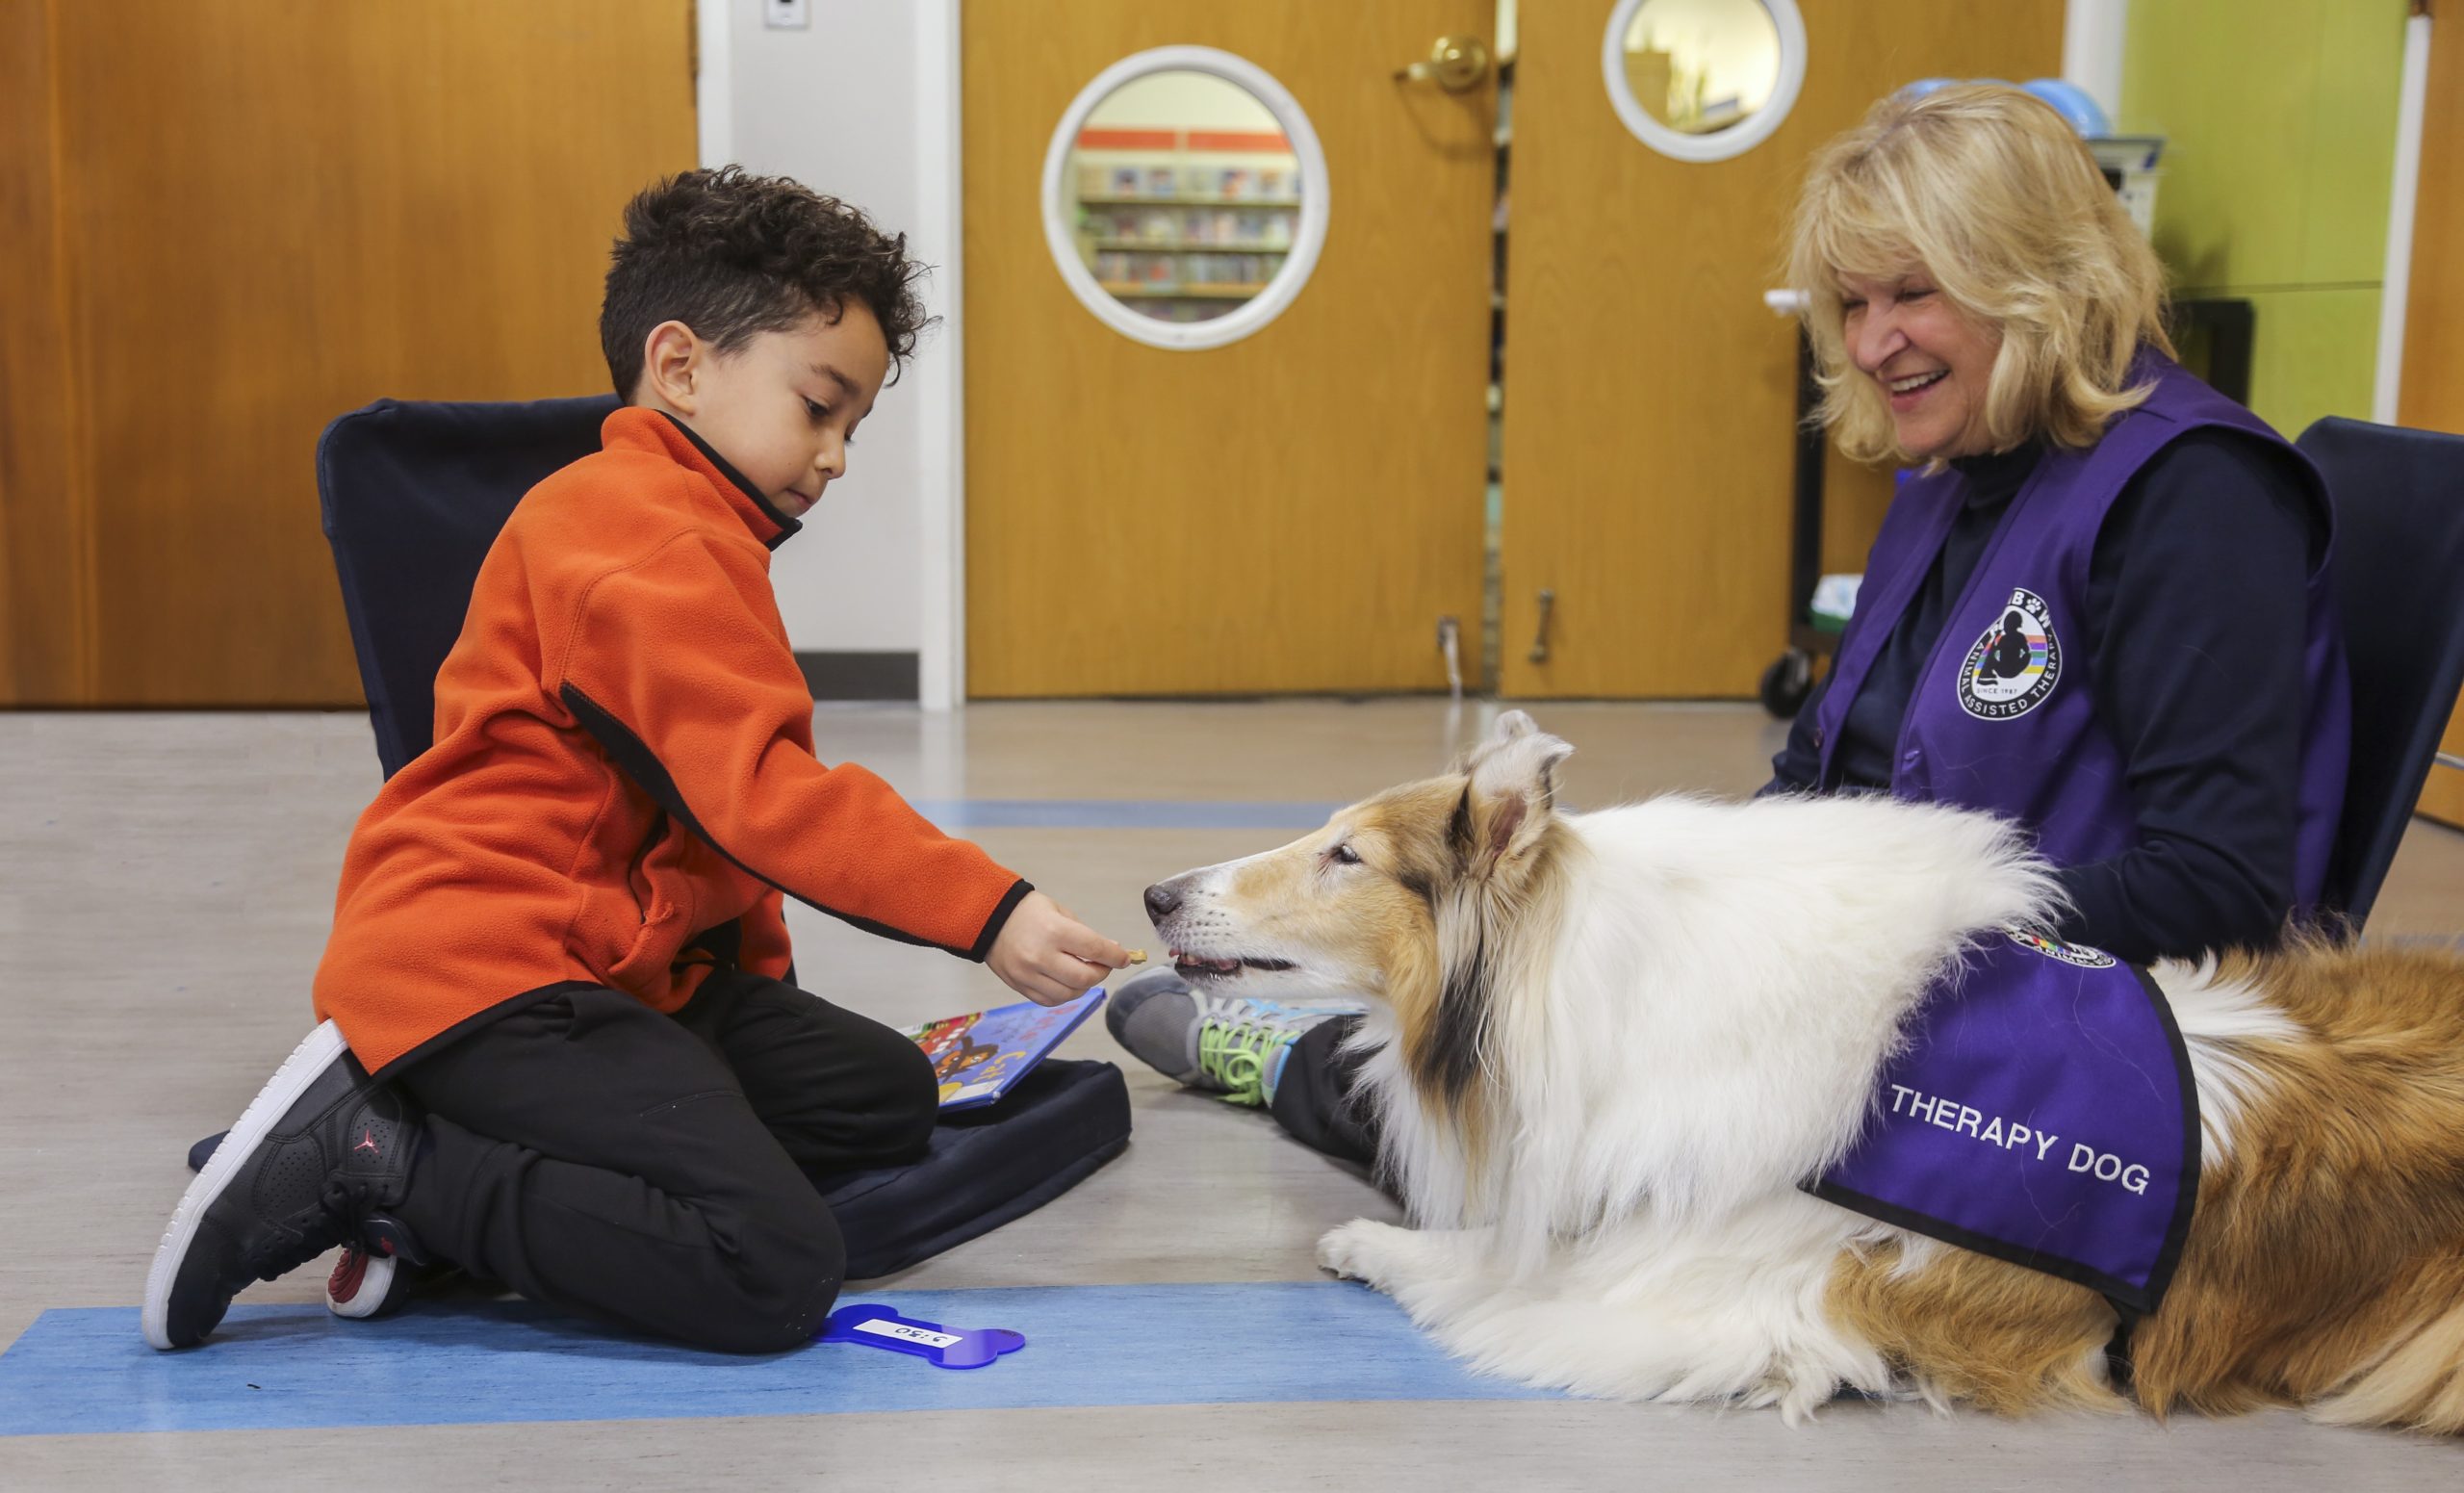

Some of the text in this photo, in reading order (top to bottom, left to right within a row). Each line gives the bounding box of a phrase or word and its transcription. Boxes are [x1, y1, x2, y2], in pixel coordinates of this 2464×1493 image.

[1960, 633, 2057, 715] ANIMAL ASSISTED THERAPY
[1890, 1083, 2150, 1196] THERAPY DOG
